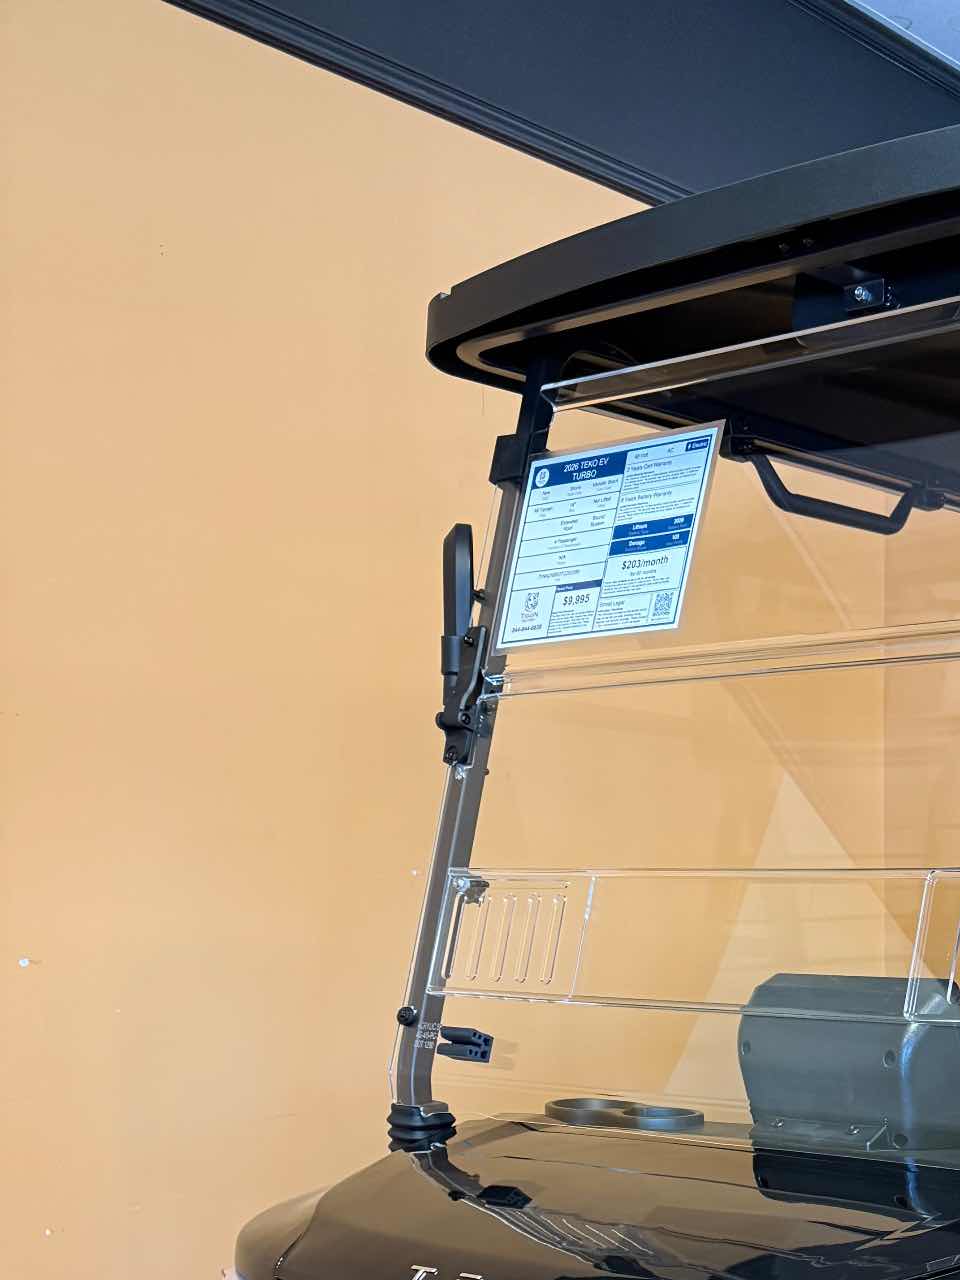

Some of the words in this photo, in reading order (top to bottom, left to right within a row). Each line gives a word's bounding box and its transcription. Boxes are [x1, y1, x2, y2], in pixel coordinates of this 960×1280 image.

[564, 462, 579, 473] 2026
[580, 458, 598, 469] TEKO
[598, 457, 609, 466] EV
[572, 470, 597, 481] TURBO
[621, 555, 669, 570] $203/month
[562, 594, 590, 606] $9,995
